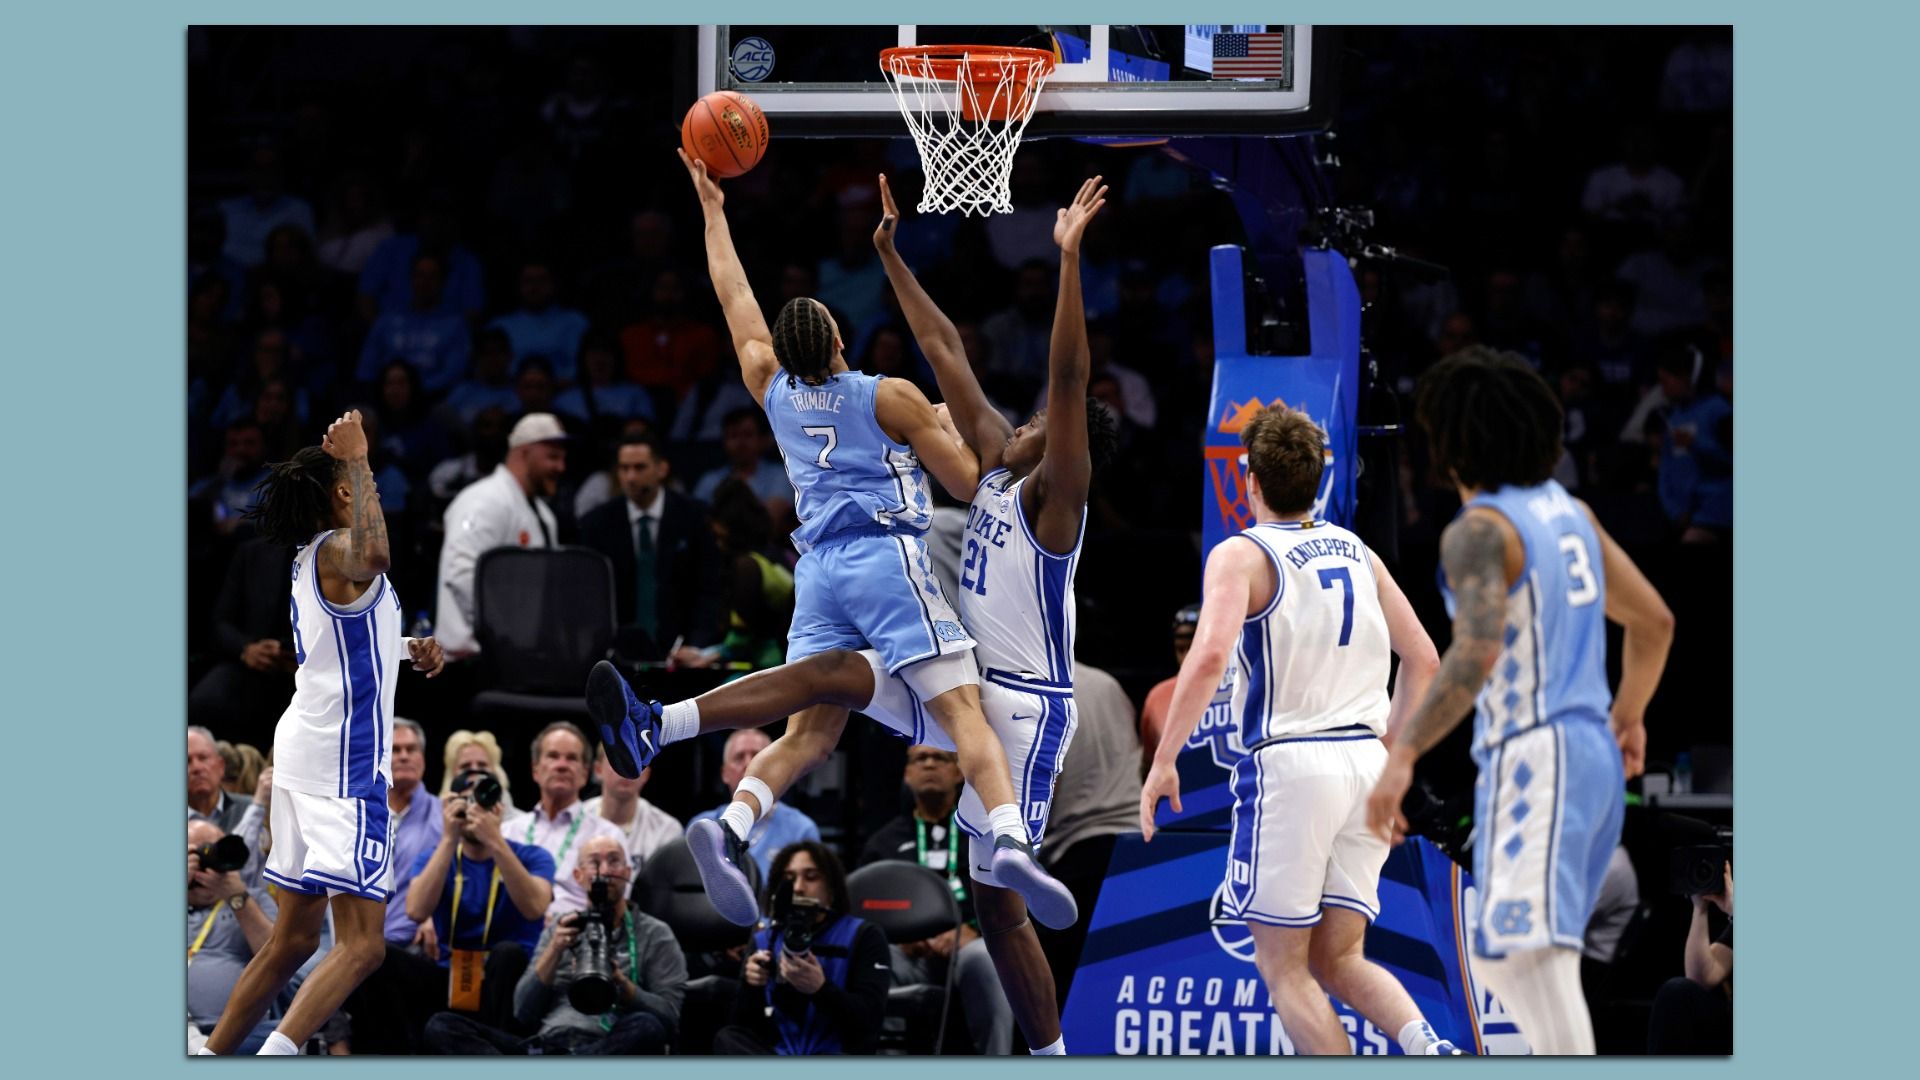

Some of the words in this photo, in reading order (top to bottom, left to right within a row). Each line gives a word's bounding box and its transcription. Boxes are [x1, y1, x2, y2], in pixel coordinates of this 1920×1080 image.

[736, 51, 772, 62] ACC
[723, 104, 754, 151] LEGACY
[789, 390, 846, 414] TRIMBLE
[801, 425, 838, 471] 7
[960, 538, 988, 597] 21
[1285, 538, 1362, 571] KNUEPPEL
[1558, 533, 1599, 607] 3
[1316, 566, 1355, 648] 7
[1029, 800, 1047, 821] D
[362, 836, 384, 862] D
[1233, 858, 1250, 885] D
[1116, 975, 1274, 1008] ACCOM
[1115, 1009, 1388, 1055] GREATNS
